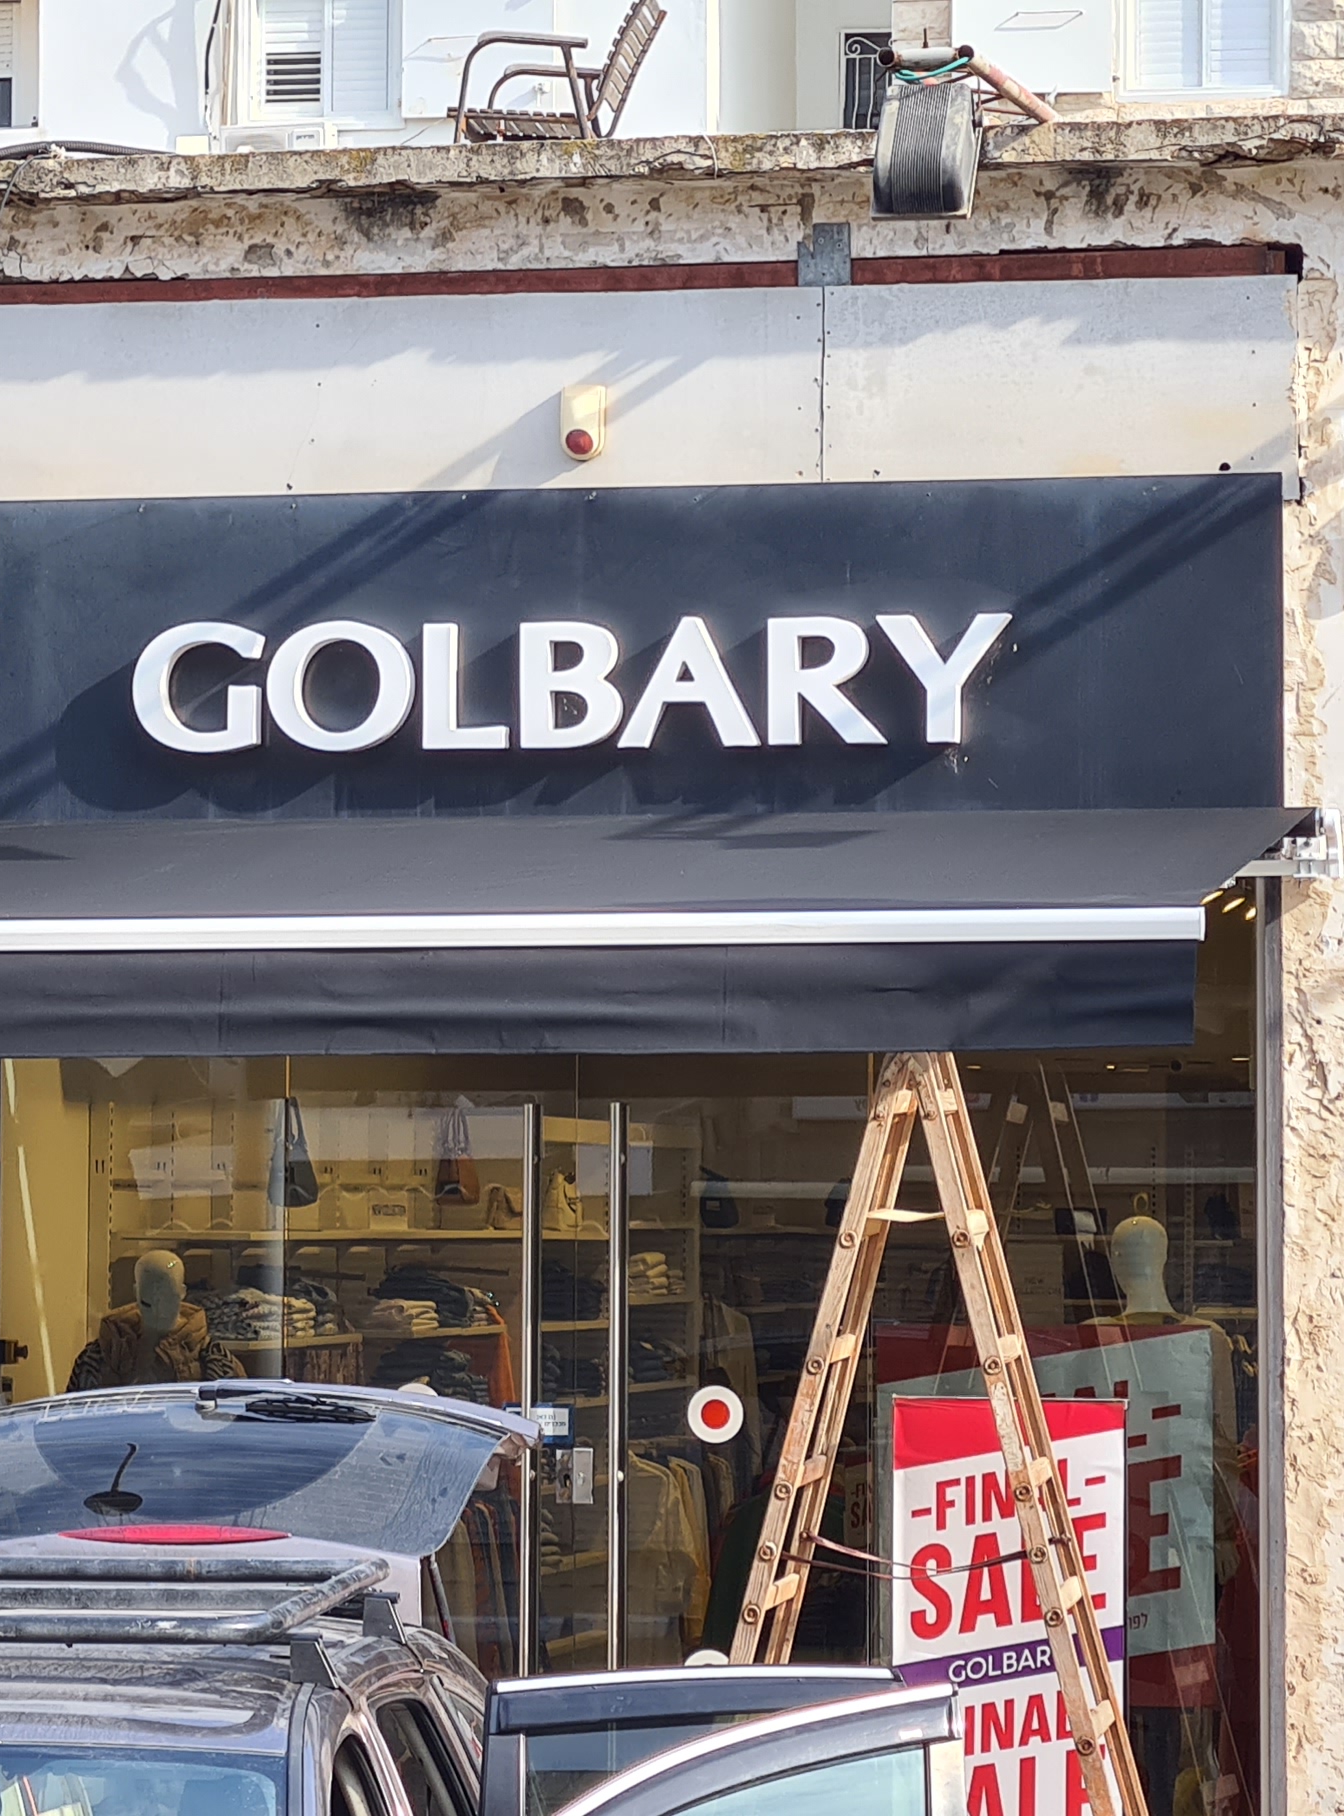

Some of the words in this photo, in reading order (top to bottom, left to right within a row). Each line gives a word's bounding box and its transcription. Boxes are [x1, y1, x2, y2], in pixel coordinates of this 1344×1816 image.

[131, 612, 1014, 754] GOLBARY
[948, 1645, 1052, 1683] GOLBAR
[963, 1690, 1074, 1756] INAL
